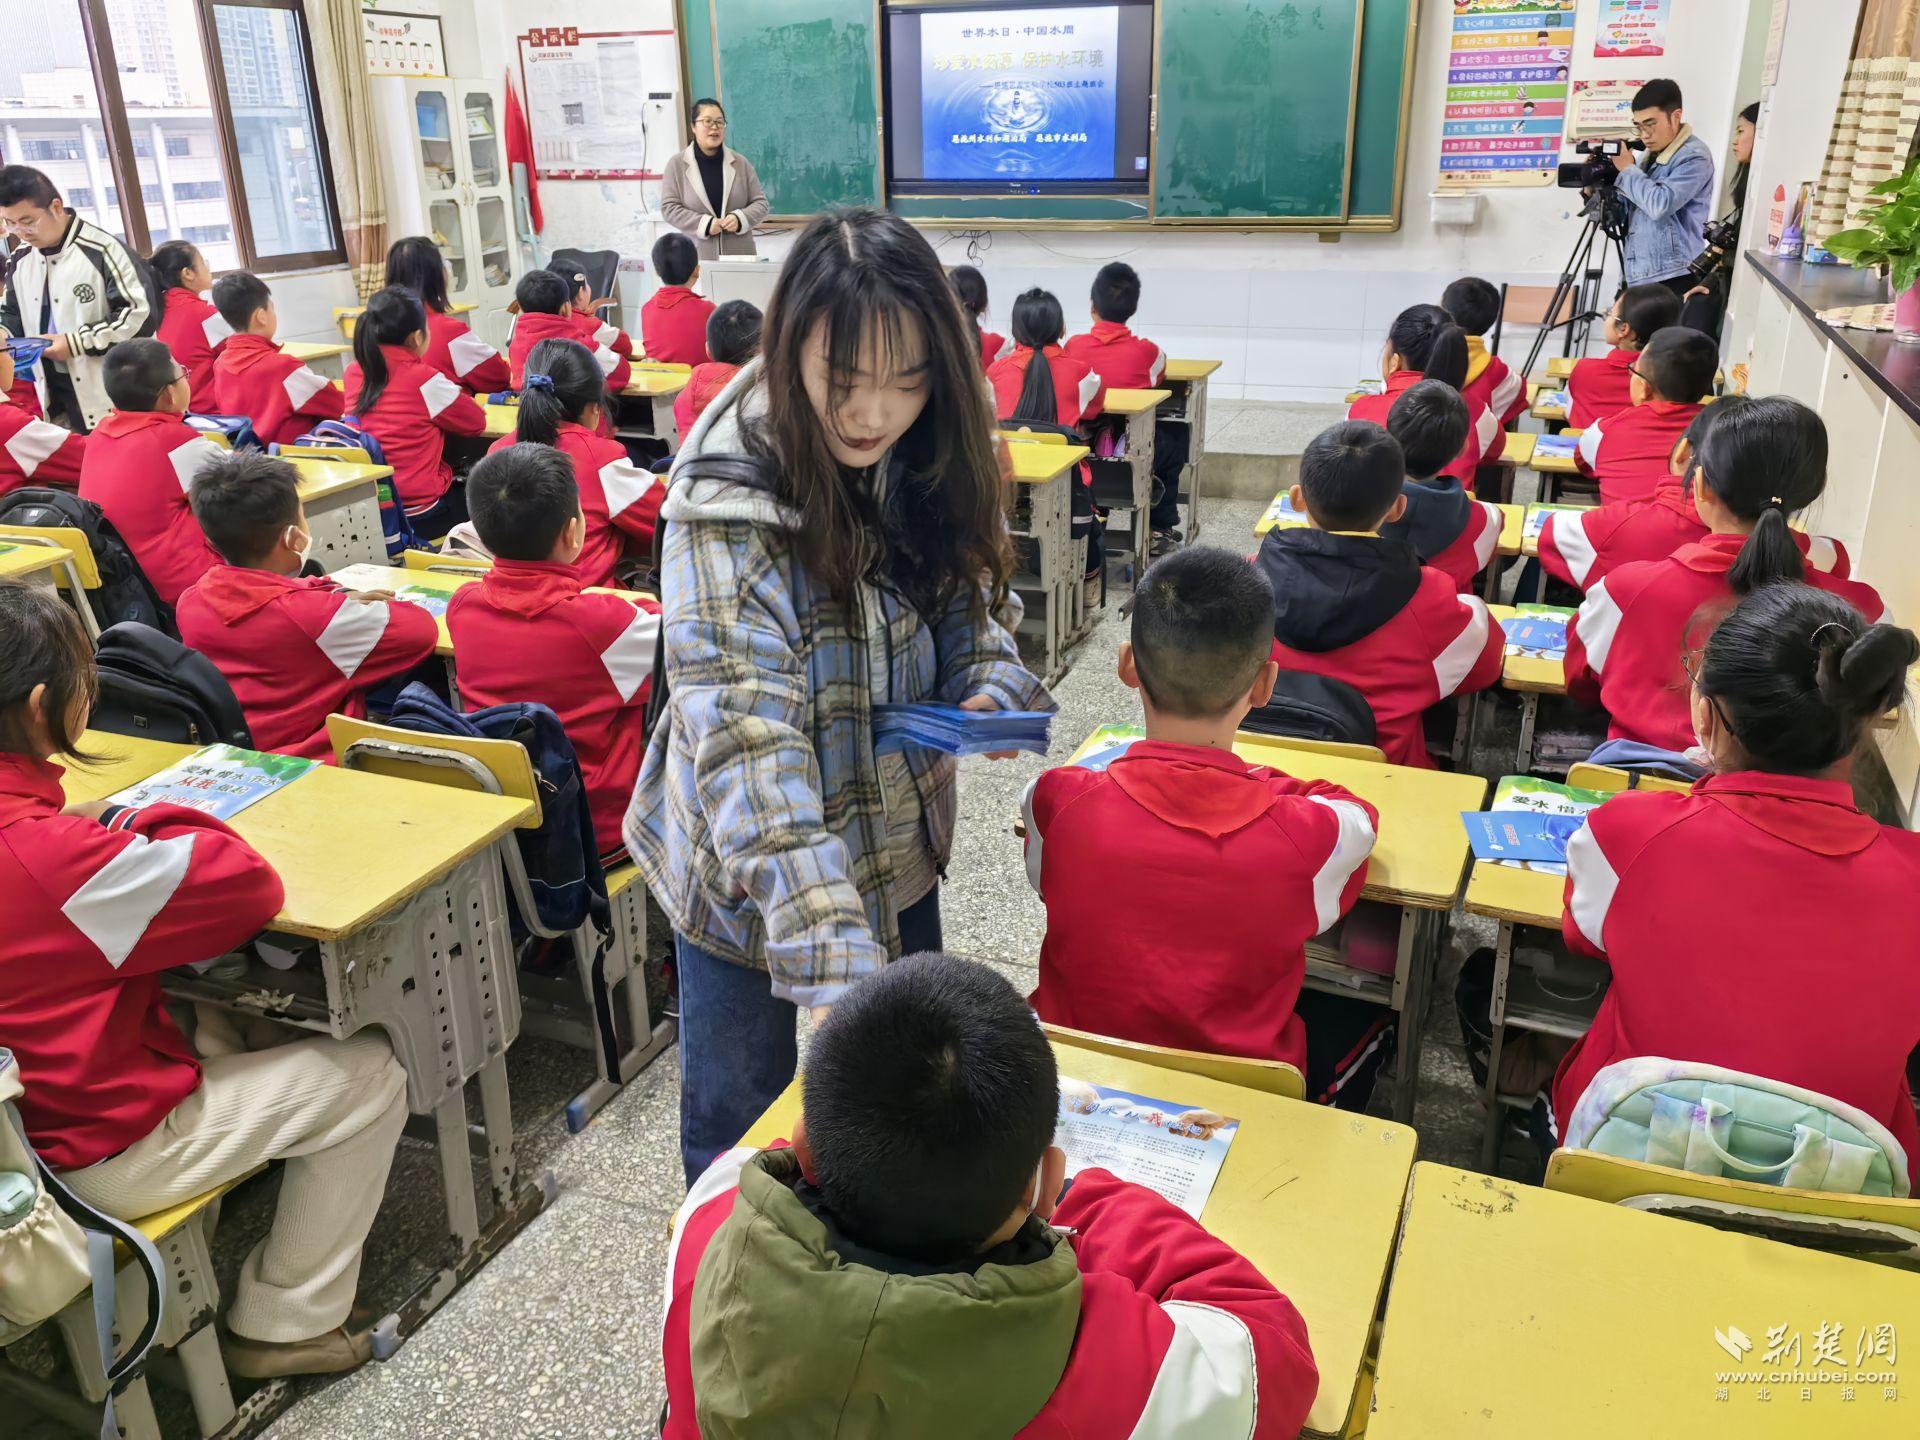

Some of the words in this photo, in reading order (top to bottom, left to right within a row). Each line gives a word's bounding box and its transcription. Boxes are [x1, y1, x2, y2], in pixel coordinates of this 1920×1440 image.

[531, 30, 577, 44] 公示栏
[962, 25, 1074, 38] 世界水日·中国水周
[1023, 49, 1104, 68] 保护水环境
[1035, 133, 1088, 143] 恩施市水利局
[181, 764, 214, 778] 爱水
[216, 770, 249, 780] 惜水
[1512, 795, 1550, 810] 爱水
